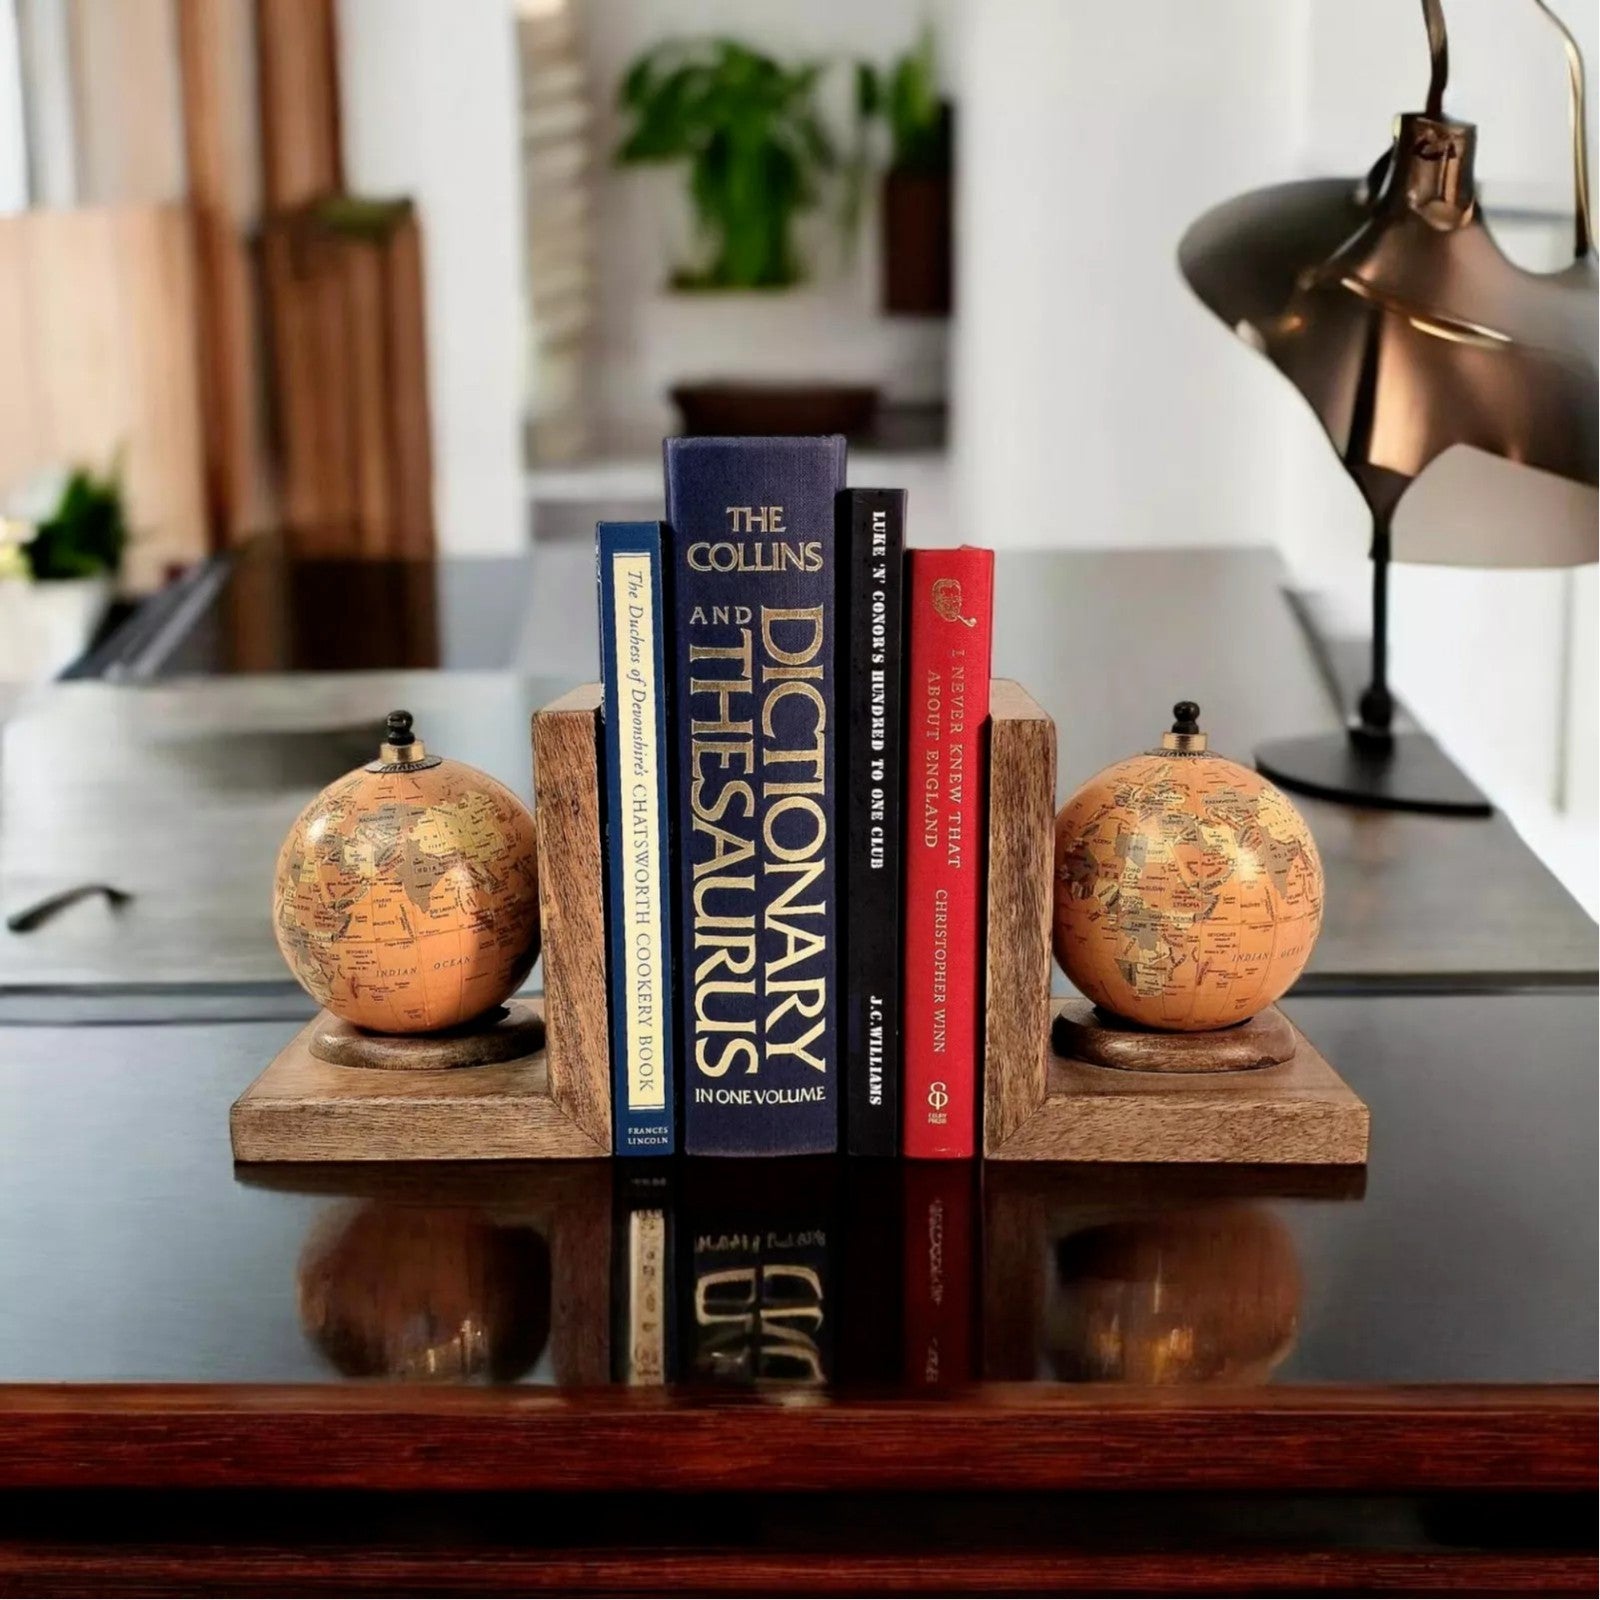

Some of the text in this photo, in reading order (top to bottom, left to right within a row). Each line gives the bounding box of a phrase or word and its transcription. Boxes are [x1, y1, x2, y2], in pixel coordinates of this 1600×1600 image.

[725, 505, 786, 533] THE
[872, 511, 886, 557] LUKE
[687, 541, 825, 573] COLLINS
[688, 606, 753, 626] AND
[871, 590, 886, 664] CONOR'S
[871, 670, 885, 751] HUNDRED
[950, 666, 965, 733] NEVER
[871, 758, 885, 782] TO
[925, 670, 941, 848] ABOUT ENGLAND
[949, 743, 963, 804] KNEW
[870, 788, 885, 821] ONE
[627, 571, 654, 1092] The Duchess of Devonshire's CHATSWORTH COOKERY BOOK
[689, 628, 759, 1078] THESAURUS
[761, 604, 828, 1074] DICTIONARY
[870, 826, 884, 869] CLUB
[948, 811, 962, 869] THAT
[376, 956, 471, 978] INDIAN OCEAN
[933, 889, 948, 1053] CHRISTOPHER WINN
[695, 1085, 826, 1105] IN ONE VOLUME
[628, 1126, 669, 1136] FRANCES
[628, 1136, 669, 1146] LINCOLN
